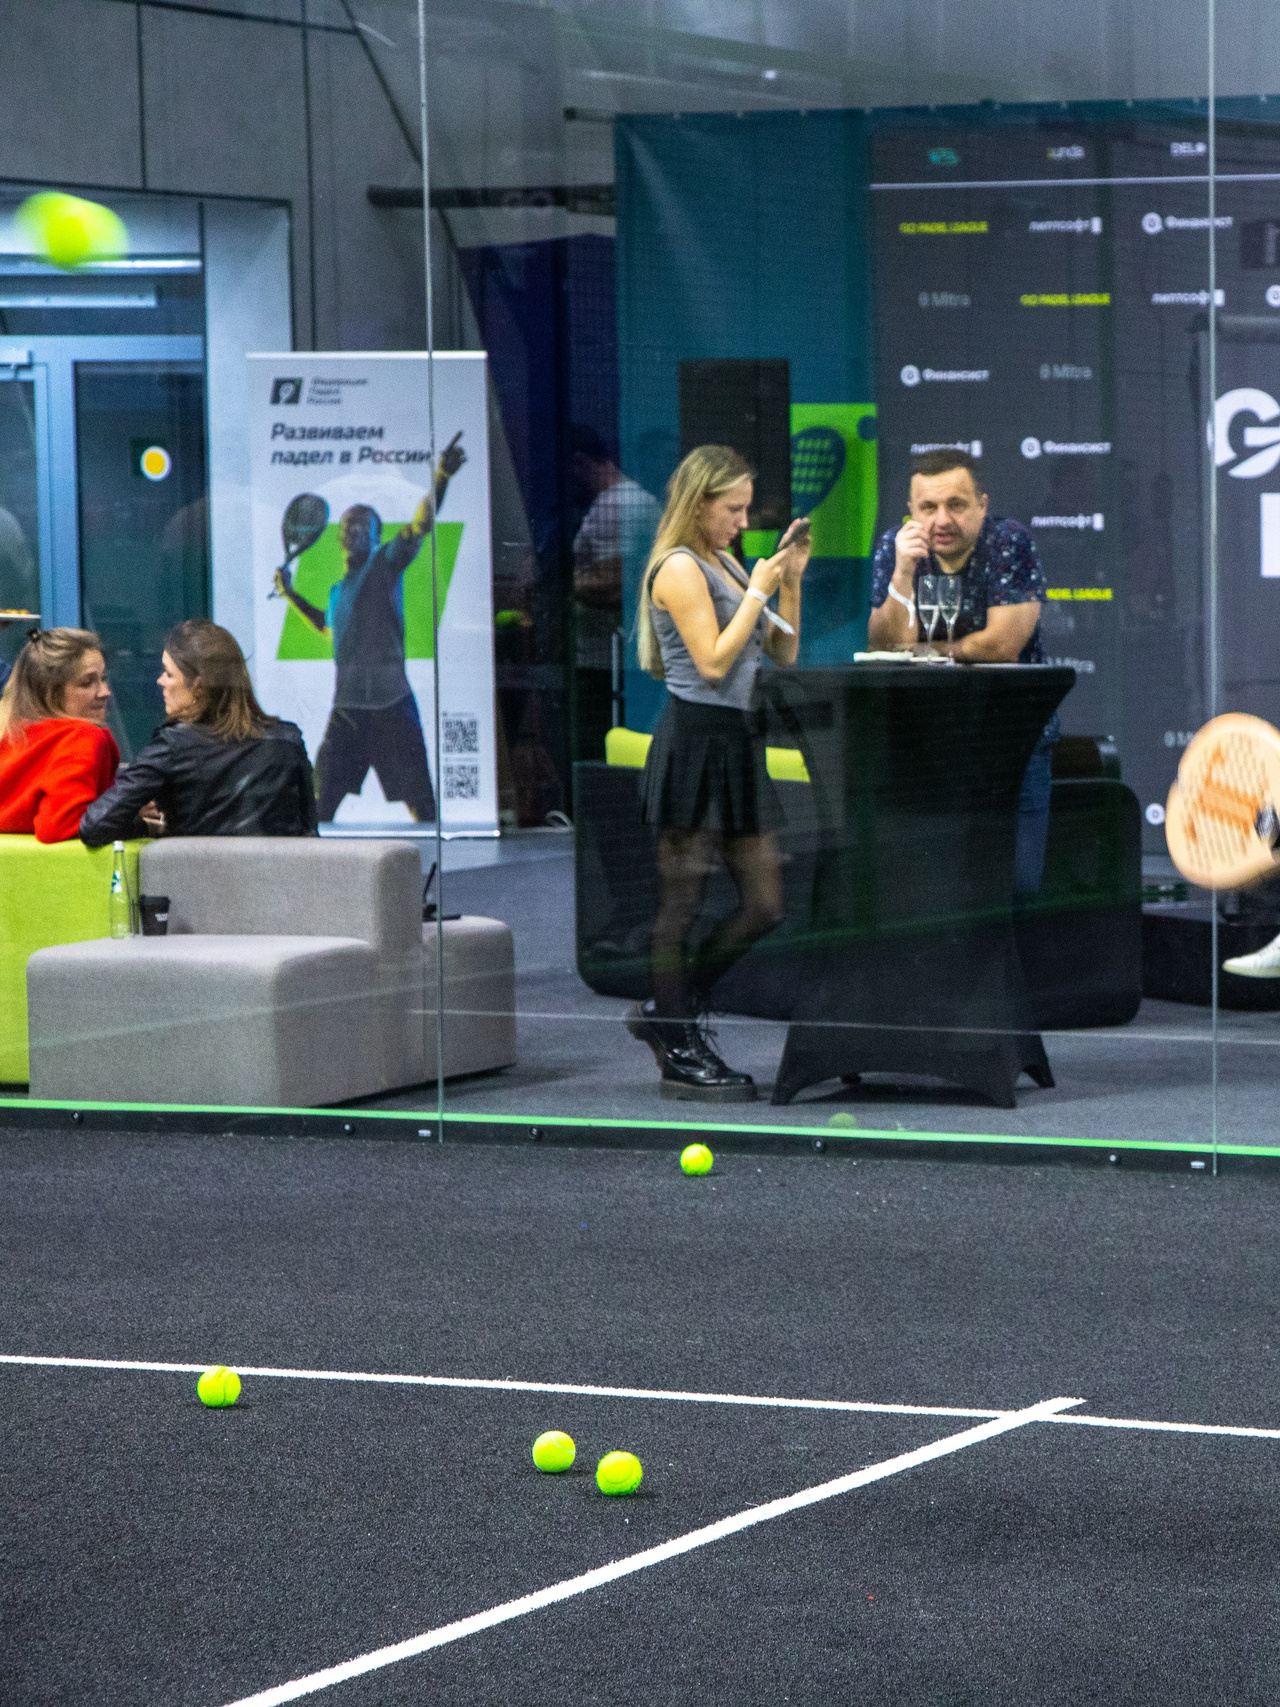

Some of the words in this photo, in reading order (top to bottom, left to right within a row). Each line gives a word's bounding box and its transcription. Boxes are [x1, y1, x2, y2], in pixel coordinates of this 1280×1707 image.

[271, 422, 385, 441] Развиваем
[271, 450, 334, 466] падел
[339, 451, 351, 464] в
[357, 446, 433, 464] России
